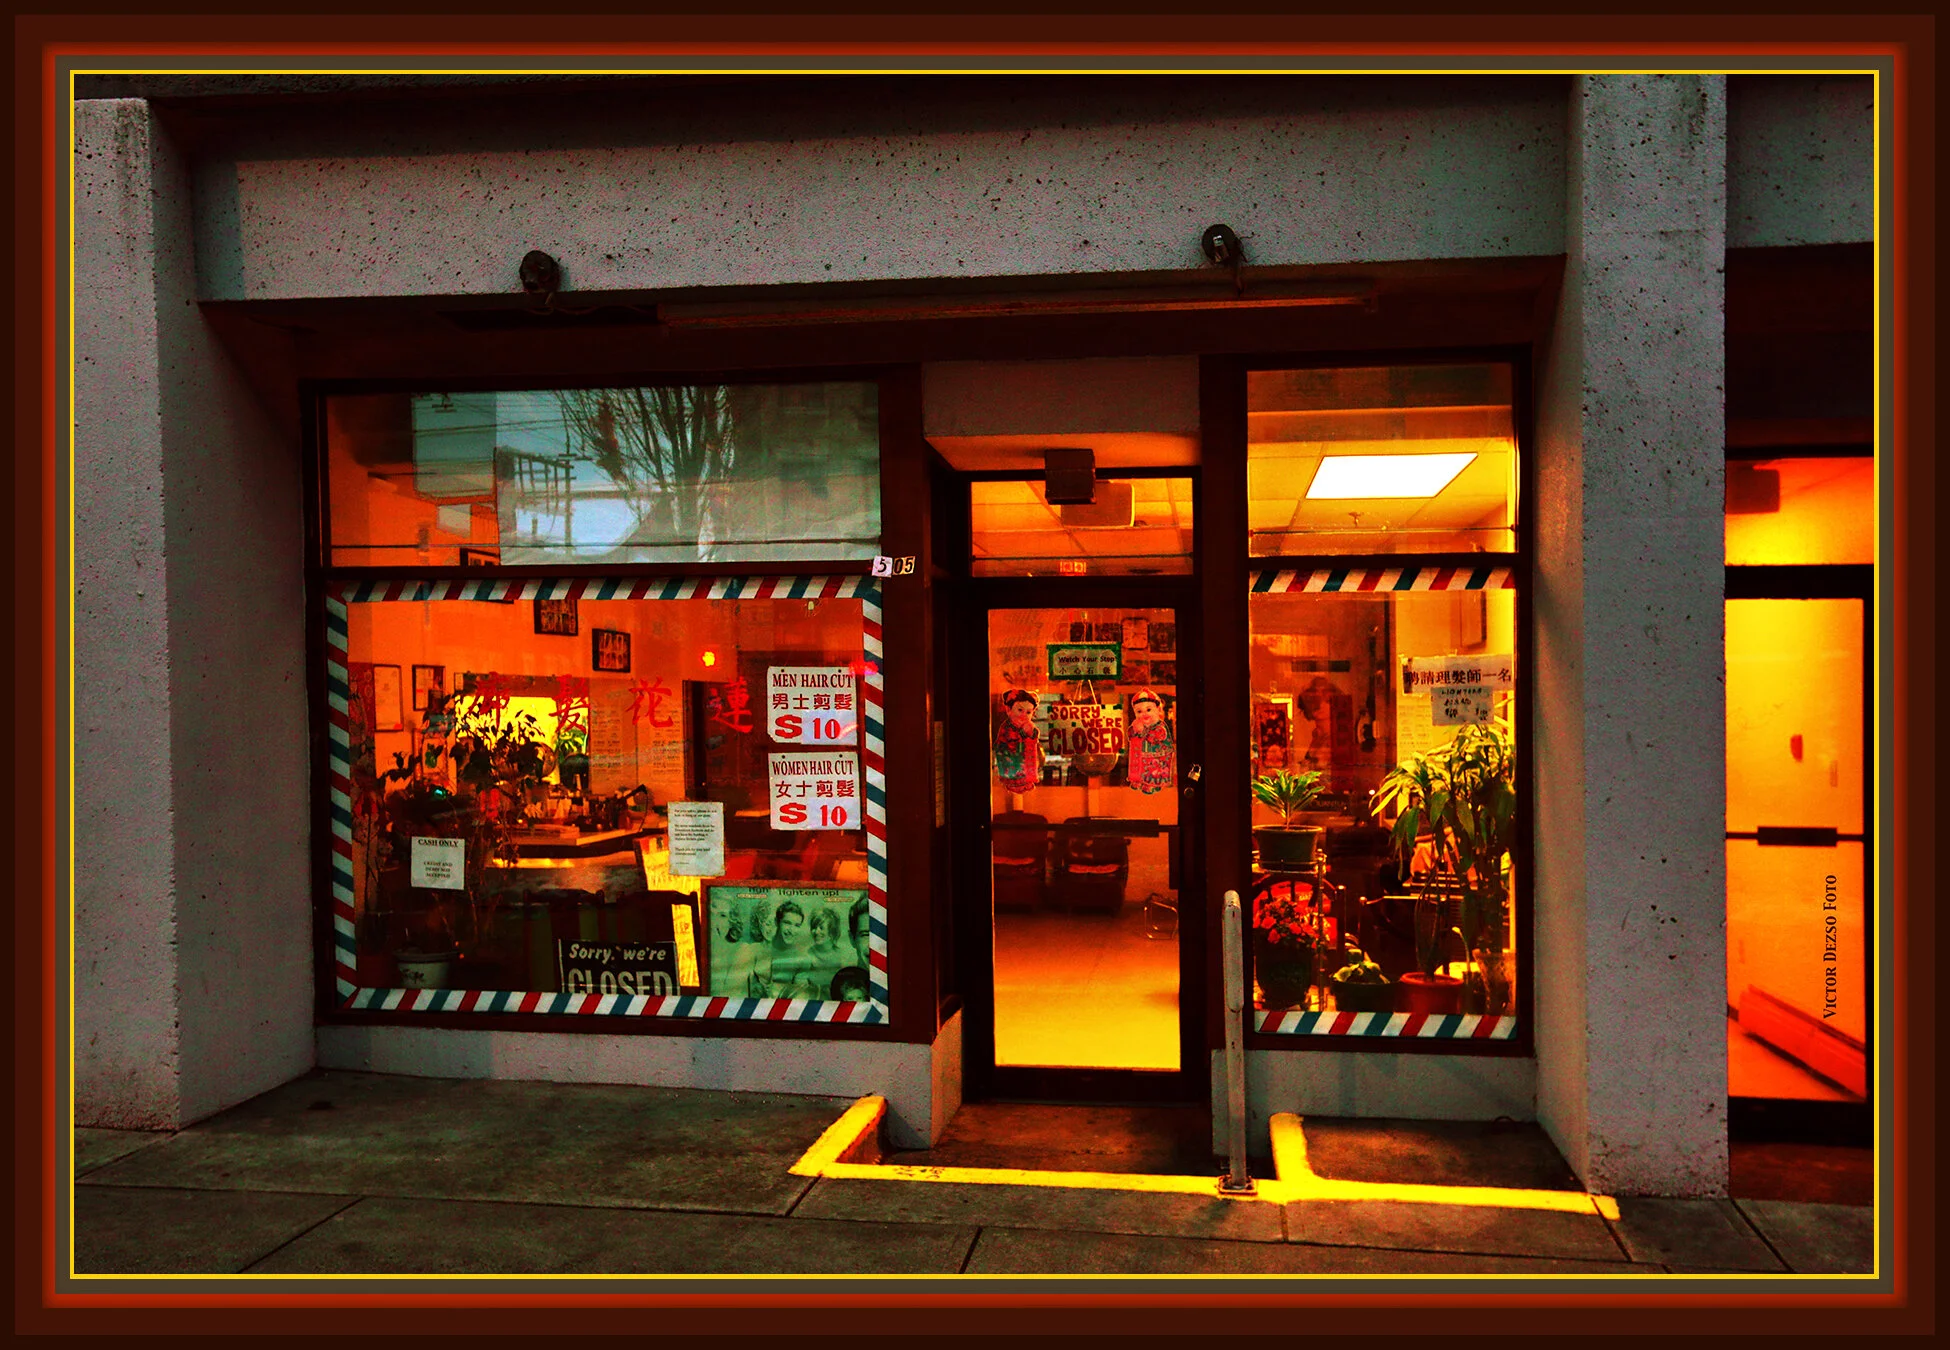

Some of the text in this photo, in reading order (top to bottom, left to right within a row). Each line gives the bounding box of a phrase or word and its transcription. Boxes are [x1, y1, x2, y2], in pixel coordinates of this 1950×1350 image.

[877, 557, 914, 574] 505
[1058, 655, 1115, 664] Watch Your Step
[772, 673, 853, 688] MEN HAIR CUT
[772, 693, 852, 710] 男士剪髮
[1050, 706, 1100, 720] SORRY
[1081, 716, 1122, 728] WE'RE
[1048, 727, 1124, 758] CLOSED
[772, 760, 854, 776] WOMEN HAIR CUT
[775, 780, 854, 798] 女士剪髮
[417, 838, 459, 848] CASH ONLY
[623, 946, 667, 961] we're
[568, 968, 673, 996] CLOSED
